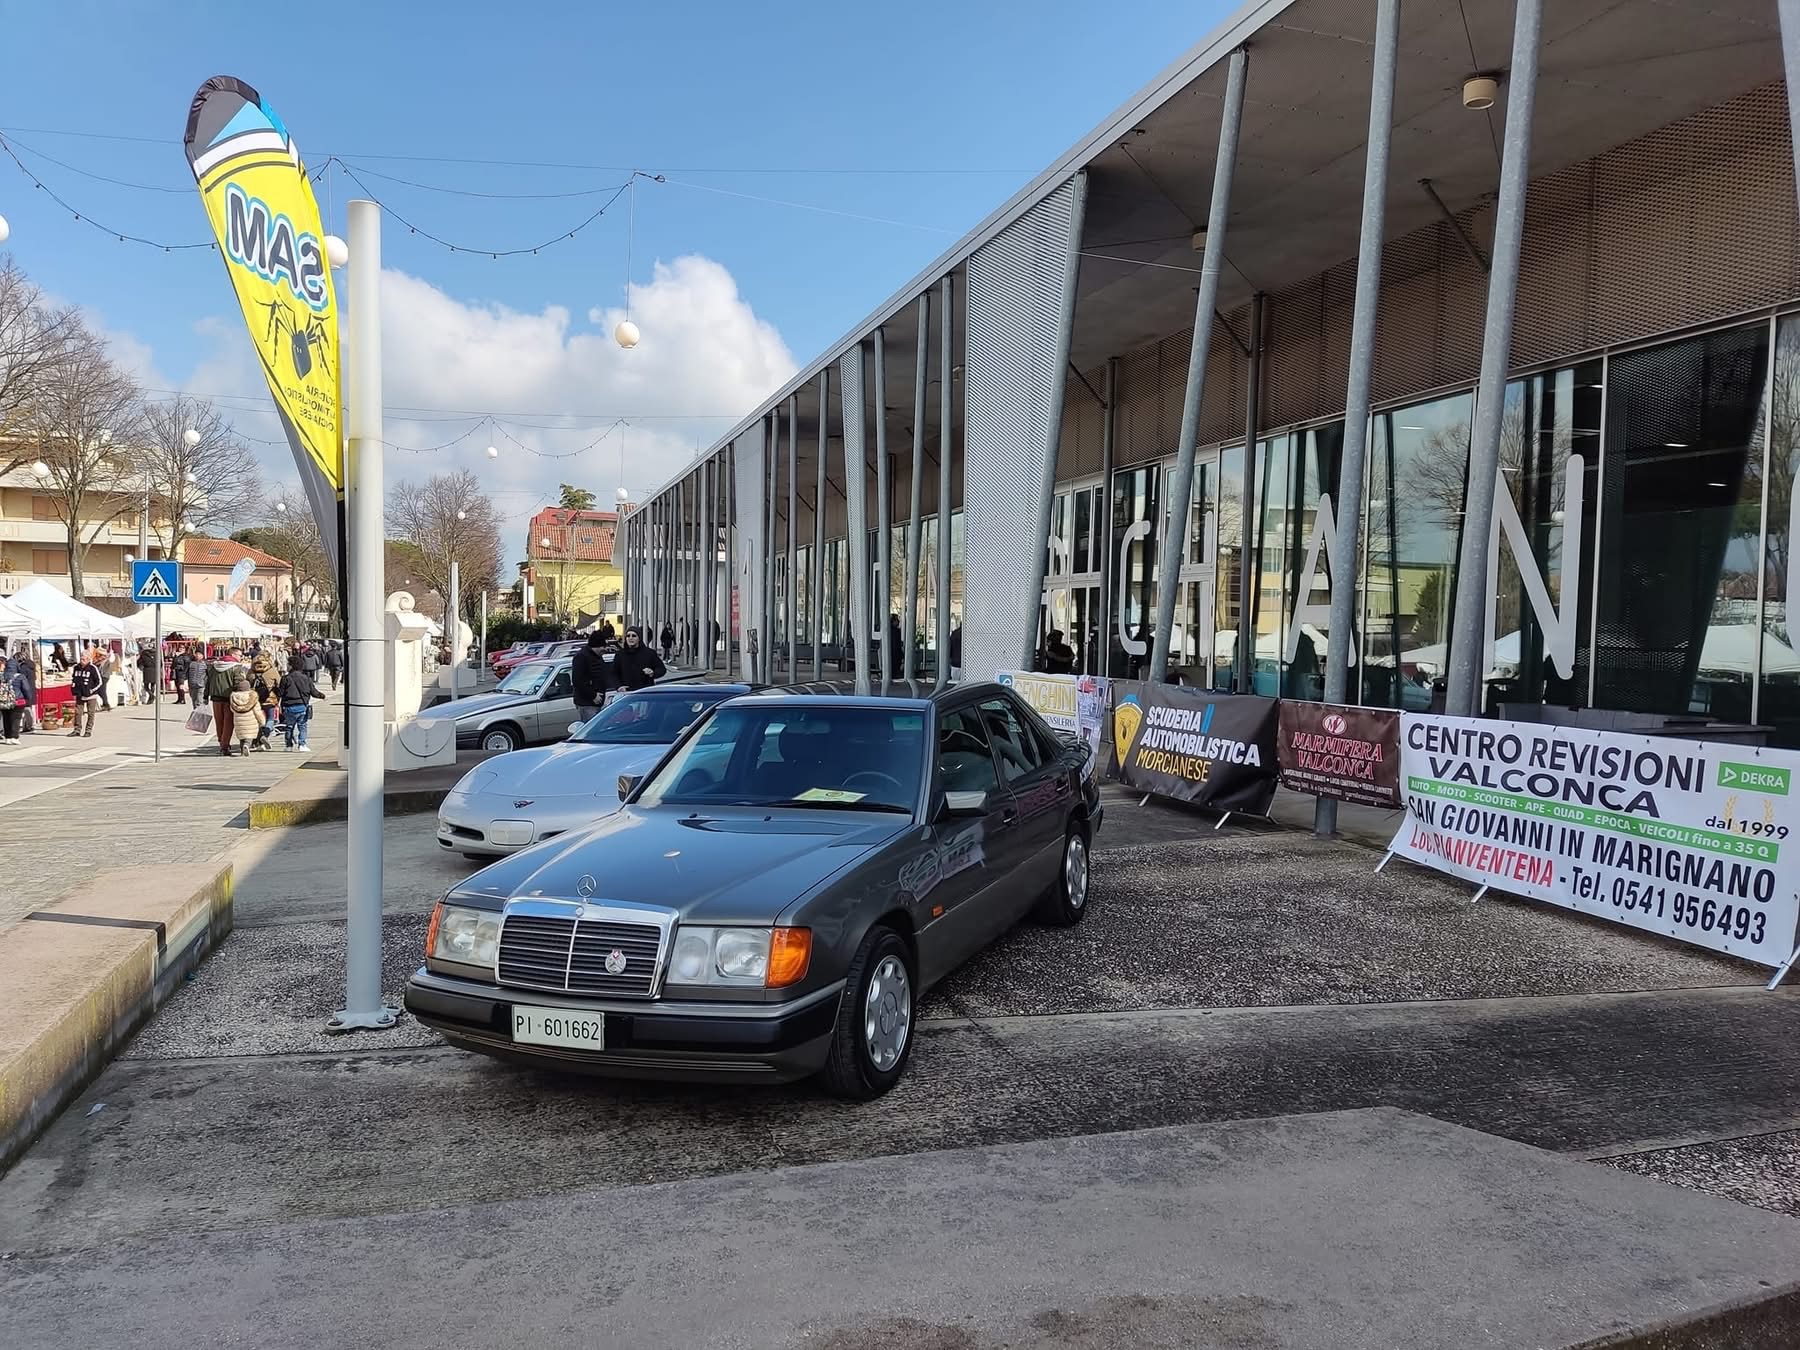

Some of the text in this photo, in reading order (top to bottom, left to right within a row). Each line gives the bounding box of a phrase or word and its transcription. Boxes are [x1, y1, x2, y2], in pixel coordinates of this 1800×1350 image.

[1146, 705, 1202, 733] SCUDERIA
[1140, 727, 1261, 767] AUTOMOBILISTICA
[1291, 731, 1383, 762] MARMIFERA
[1408, 723, 1706, 793] CENTRO REVISIONI
[1135, 748, 1212, 783] MORCIANESE
[1297, 750, 1374, 780] VALCONCA
[1740, 771, 1785, 788] DEKRA
[1429, 757, 1661, 818] VALCONCA
[1410, 780, 1430, 791] AUTO
[1437, 785, 1467, 798] MOTO
[1474, 792, 1517, 808] SCOOTER
[1525, 802, 1545, 813] APE
[1553, 806, 1584, 821] QUAD
[1594, 815, 1631, 831] EPOCA
[1639, 823, 1689, 842] VEICOLI
[1691, 834, 1721, 848] fino
[1723, 842, 1732, 850] a
[1735, 842, 1754, 855] 35
[1757, 846, 1769, 858] Q
[1705, 815, 1789, 840] dal 1999
[1408, 795, 1776, 903] SAN GIOVANNI IN MARIGNANO
[1572, 866, 1605, 902] Tel.
[1612, 877, 1666, 918] 0541
[1673, 892, 1767, 945] 956493
[516, 1015, 599, 1041] PI 601662
